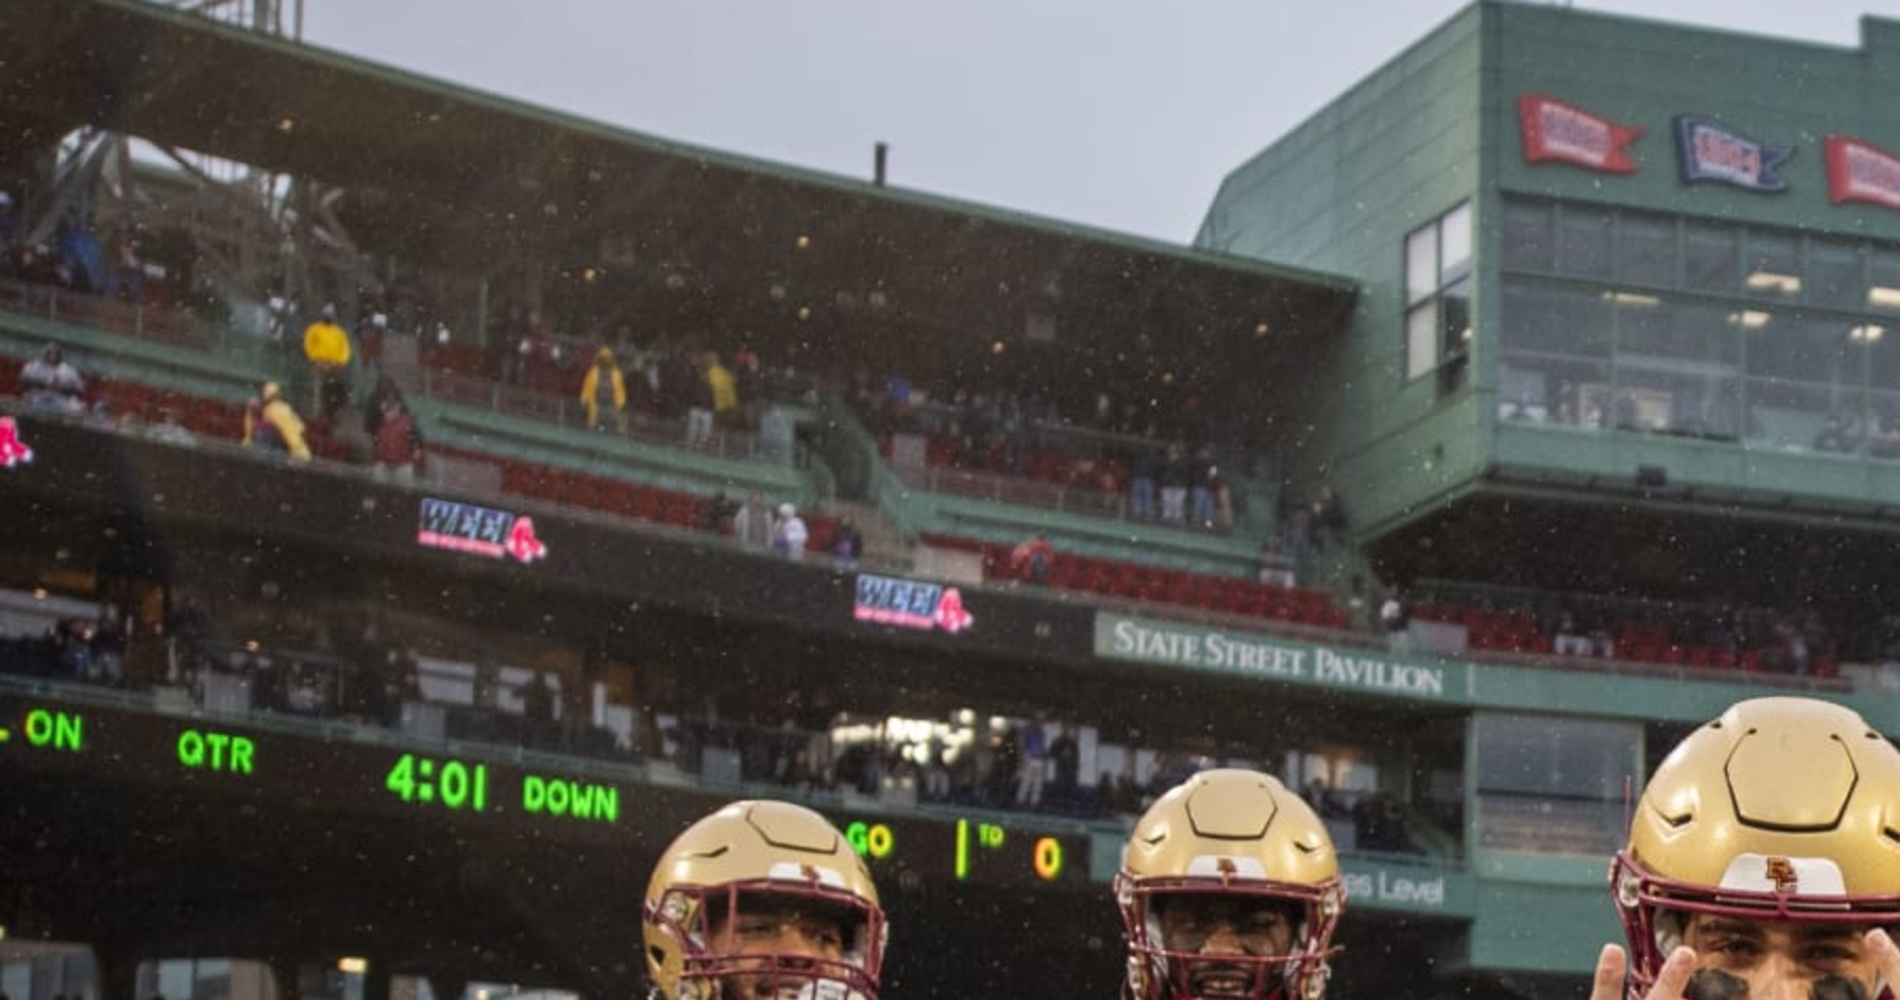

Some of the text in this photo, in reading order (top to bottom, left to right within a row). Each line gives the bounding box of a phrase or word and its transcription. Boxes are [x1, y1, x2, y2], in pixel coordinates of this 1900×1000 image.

[1114, 620, 1443, 695] STATE STREET PAVILION
[25, 710, 82, 750] ON
[178, 731, 254, 773] QTR
[387, 754, 486, 811] 4:01
[523, 776, 618, 822] DOWN
[845, 821, 893, 858] GO
